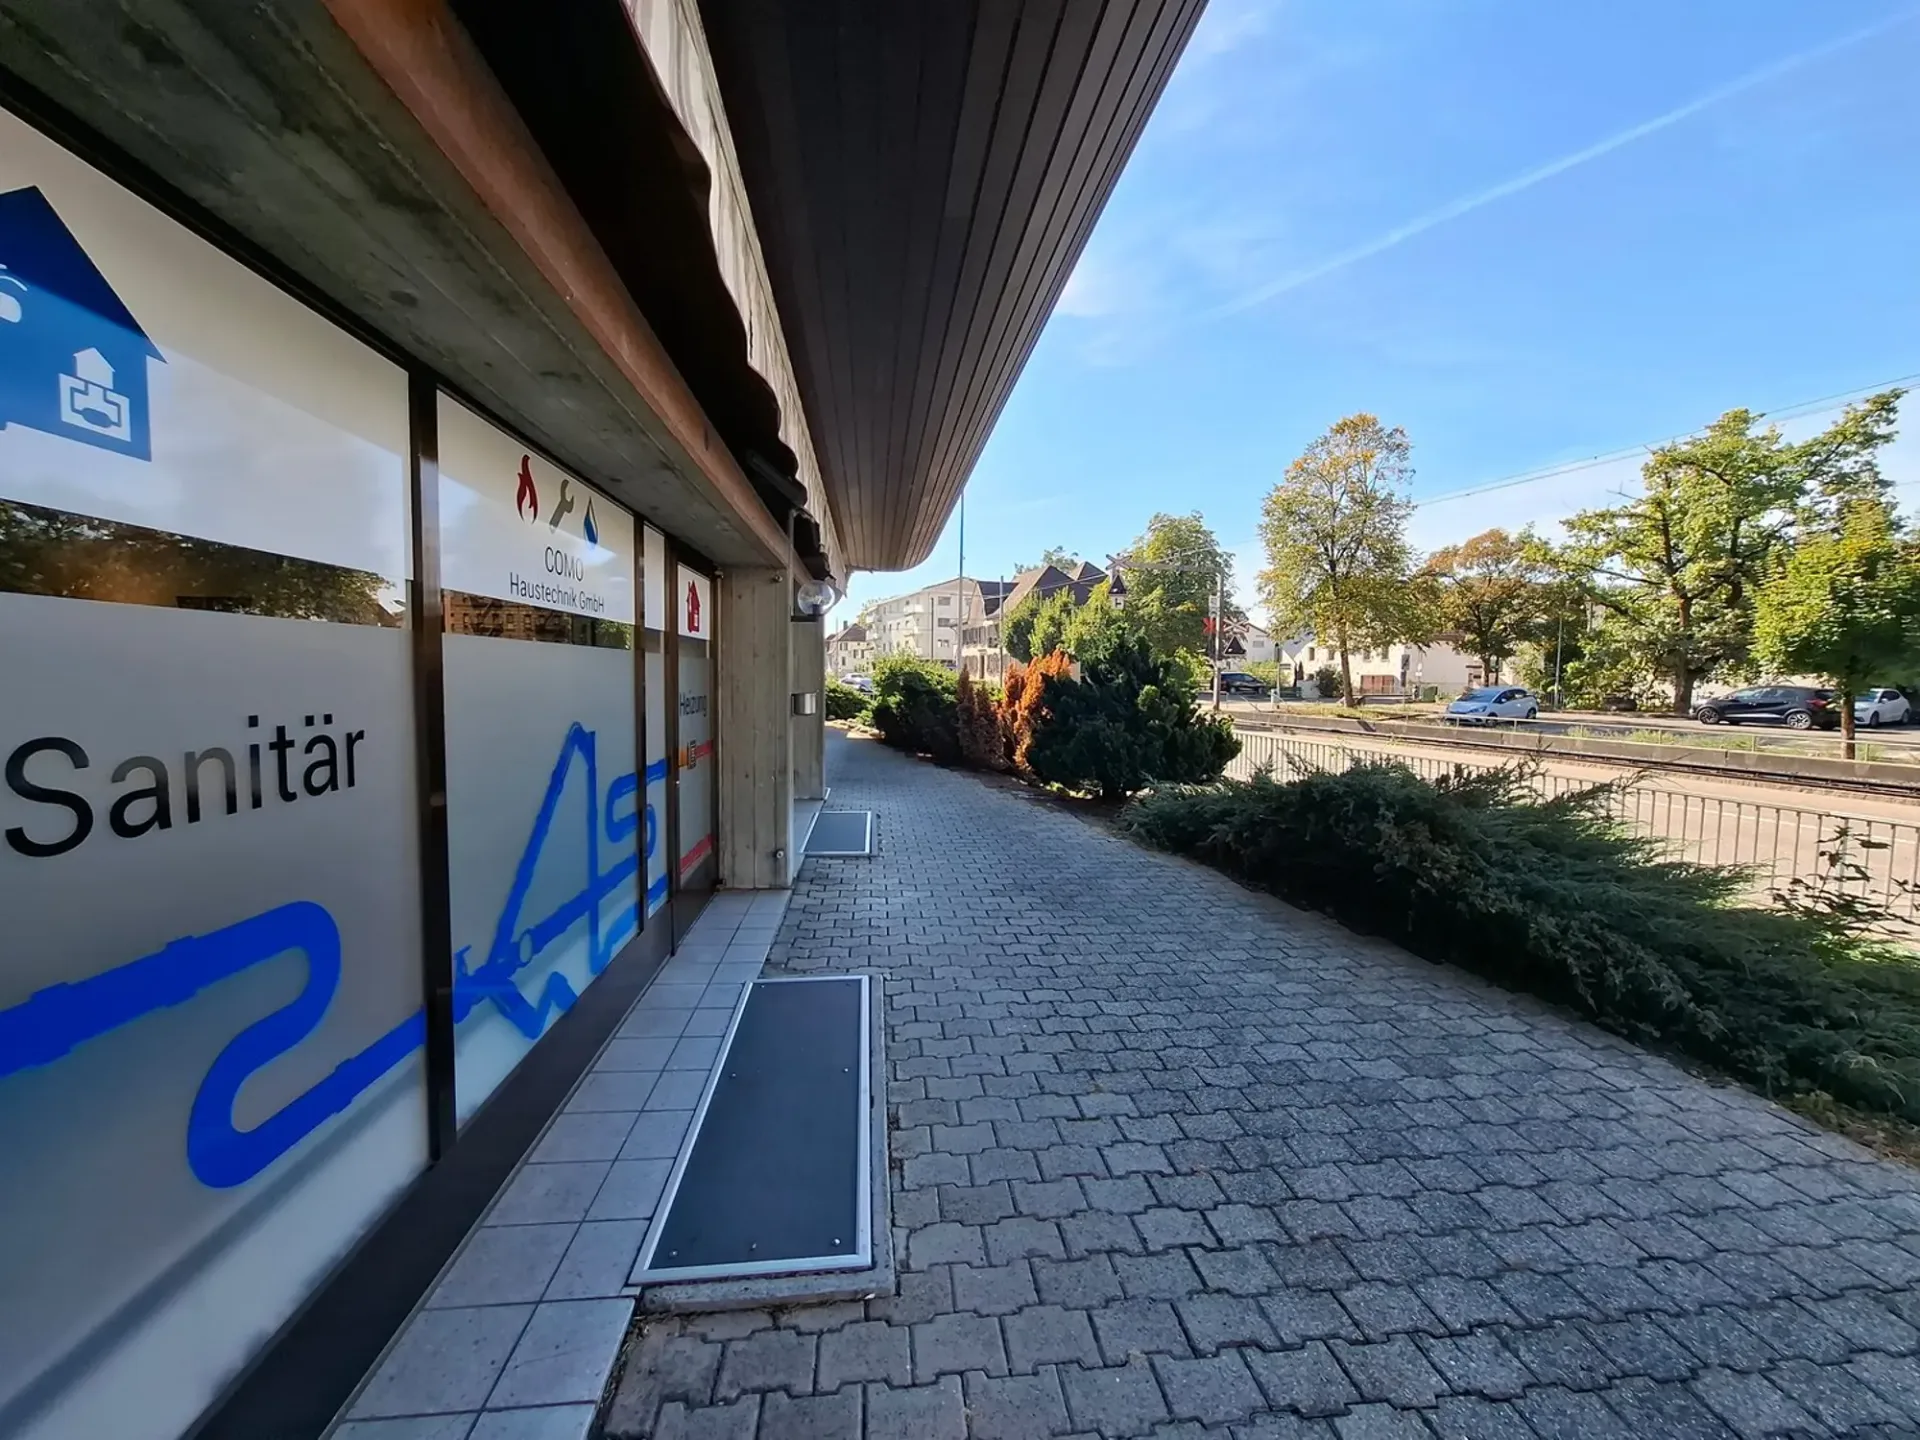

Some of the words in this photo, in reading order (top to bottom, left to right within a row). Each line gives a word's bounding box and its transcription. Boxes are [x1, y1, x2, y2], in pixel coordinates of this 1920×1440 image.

[544, 546, 583, 582] COMO
[509, 572, 577, 608] Haustechnik
[579, 591, 604, 612] GmbH
[680, 690, 707, 718] Heizung
[5, 713, 365, 858] Sanitär
